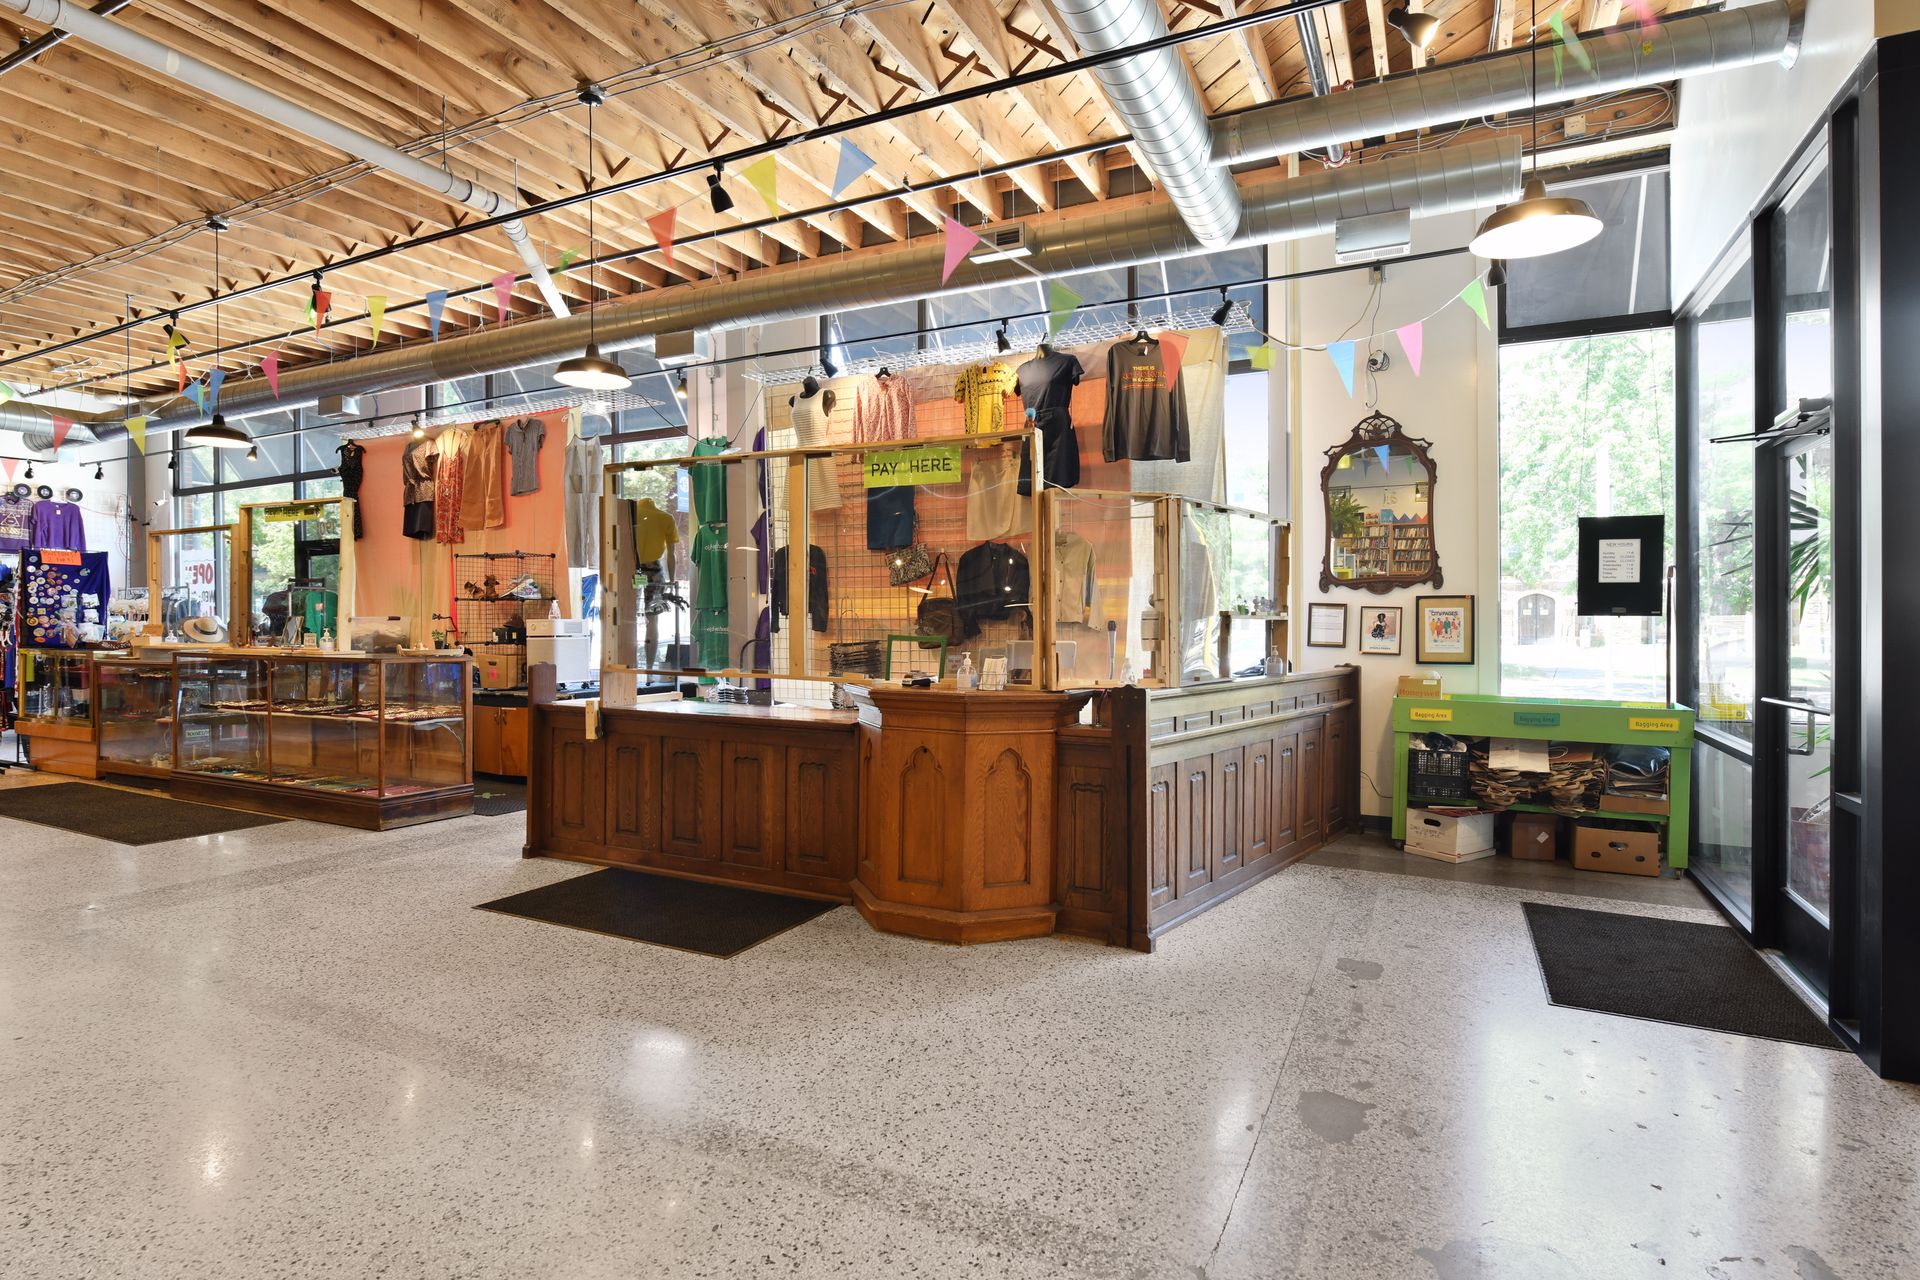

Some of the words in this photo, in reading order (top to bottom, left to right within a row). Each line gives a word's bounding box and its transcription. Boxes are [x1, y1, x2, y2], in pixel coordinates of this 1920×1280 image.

[871, 462, 898, 477] PAY
[910, 457, 952, 473] HERE
[1399, 687, 1440, 697] Honeywell
[1414, 711, 1435, 719] Bagging
[1635, 721, 1659, 729] Bagging
